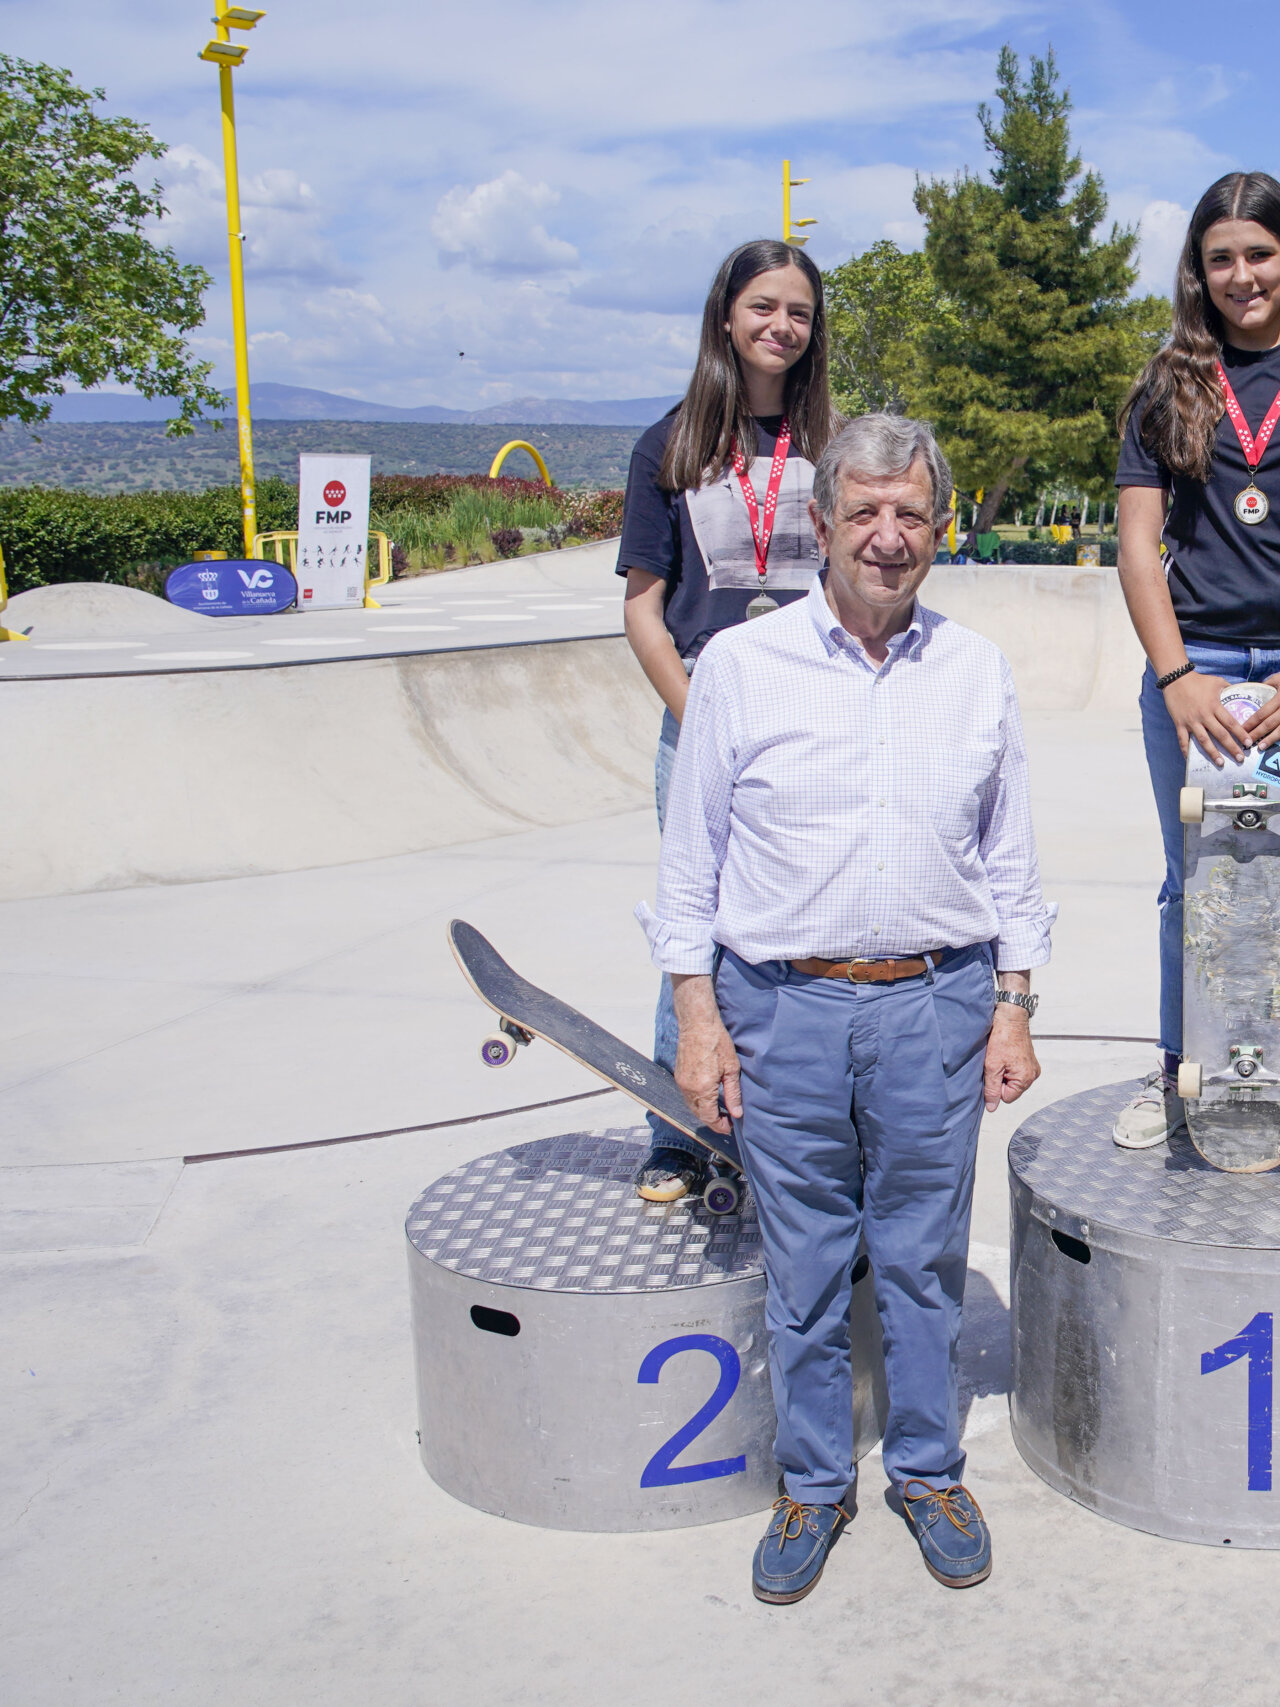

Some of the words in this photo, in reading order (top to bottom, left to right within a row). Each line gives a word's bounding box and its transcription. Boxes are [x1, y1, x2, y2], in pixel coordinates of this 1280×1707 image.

[316, 511, 352, 524] FMP
[237, 569, 274, 589] VC
[241, 590, 276, 599] Villanueva
[637, 1333, 747, 1489] 2
[1201, 1312, 1274, 1492] 1
